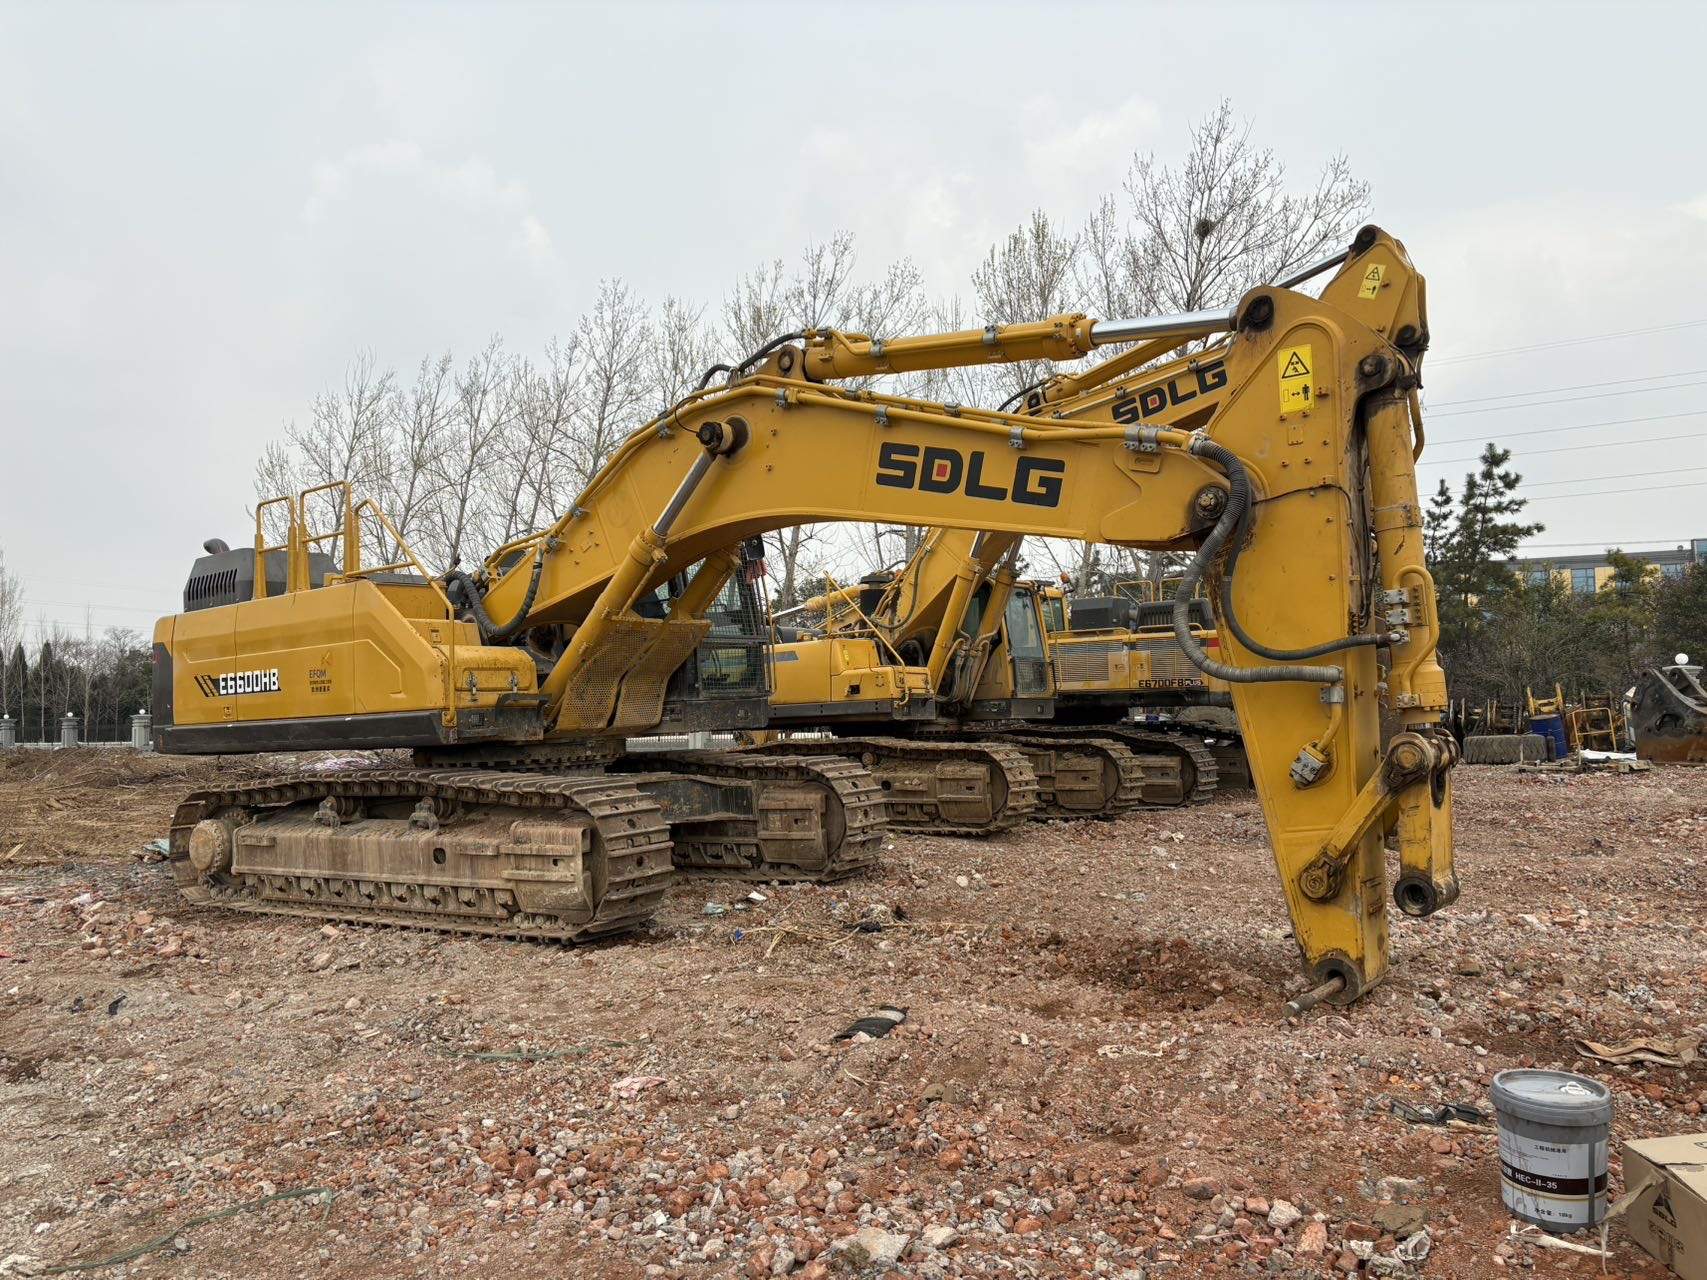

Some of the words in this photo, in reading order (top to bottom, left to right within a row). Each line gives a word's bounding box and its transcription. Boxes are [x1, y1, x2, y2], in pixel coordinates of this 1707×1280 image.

[1111, 360, 1228, 424] SDLG
[876, 441, 1066, 508] SDLG
[219, 668, 279, 695] E6600HB
